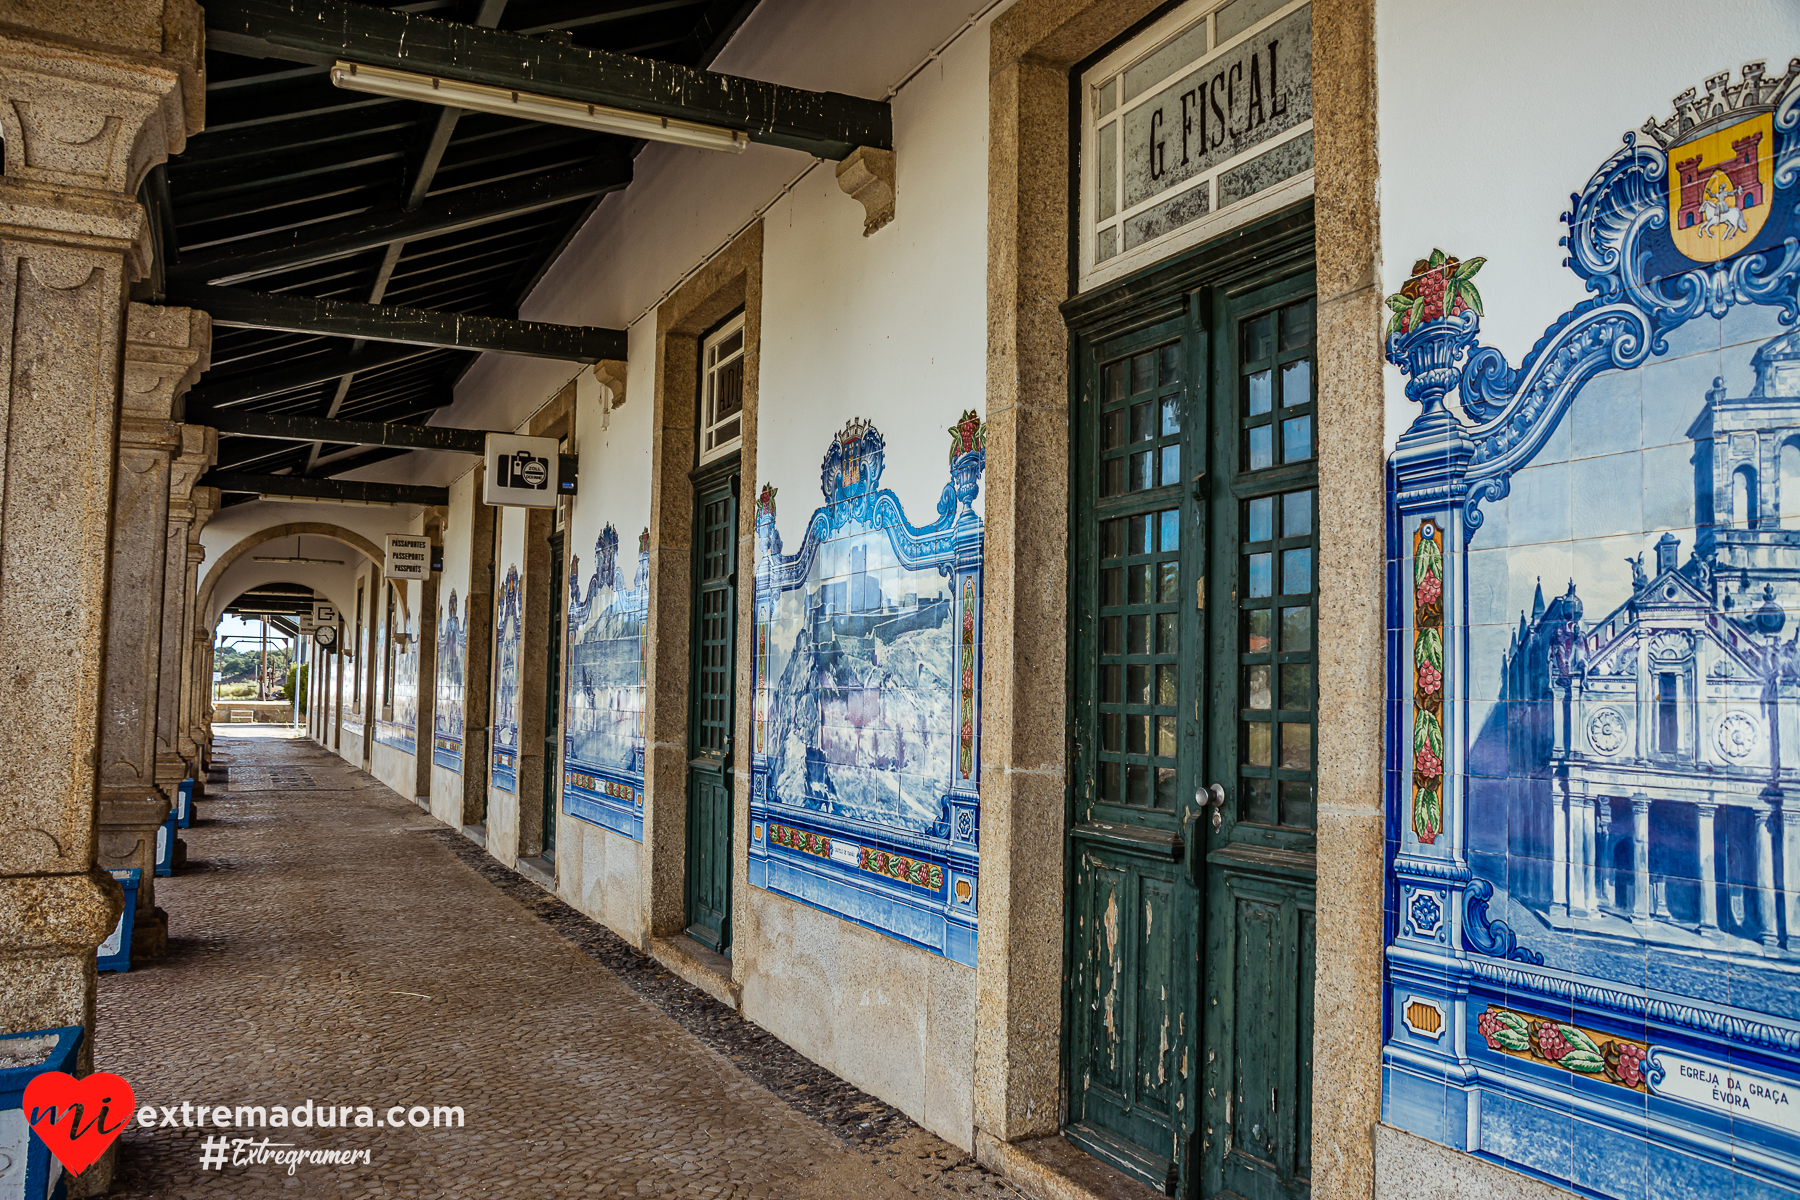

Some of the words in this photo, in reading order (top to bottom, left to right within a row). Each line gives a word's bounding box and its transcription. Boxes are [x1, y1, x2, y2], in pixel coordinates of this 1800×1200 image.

[1150, 107, 1165, 181] G
[1180, 40, 1287, 167] FISCAL
[391, 539, 426, 548] PASSAPORTES
[392, 552, 424, 561] PASSEPORTS
[394, 564, 421, 573] PASSPORTS
[1680, 1064, 1719, 1086] EGREJA
[1727, 1077, 1742, 1091] DA
[1749, 1083, 1789, 1105] GRAÇA
[1712, 1085, 1750, 1110] ÉVORA
